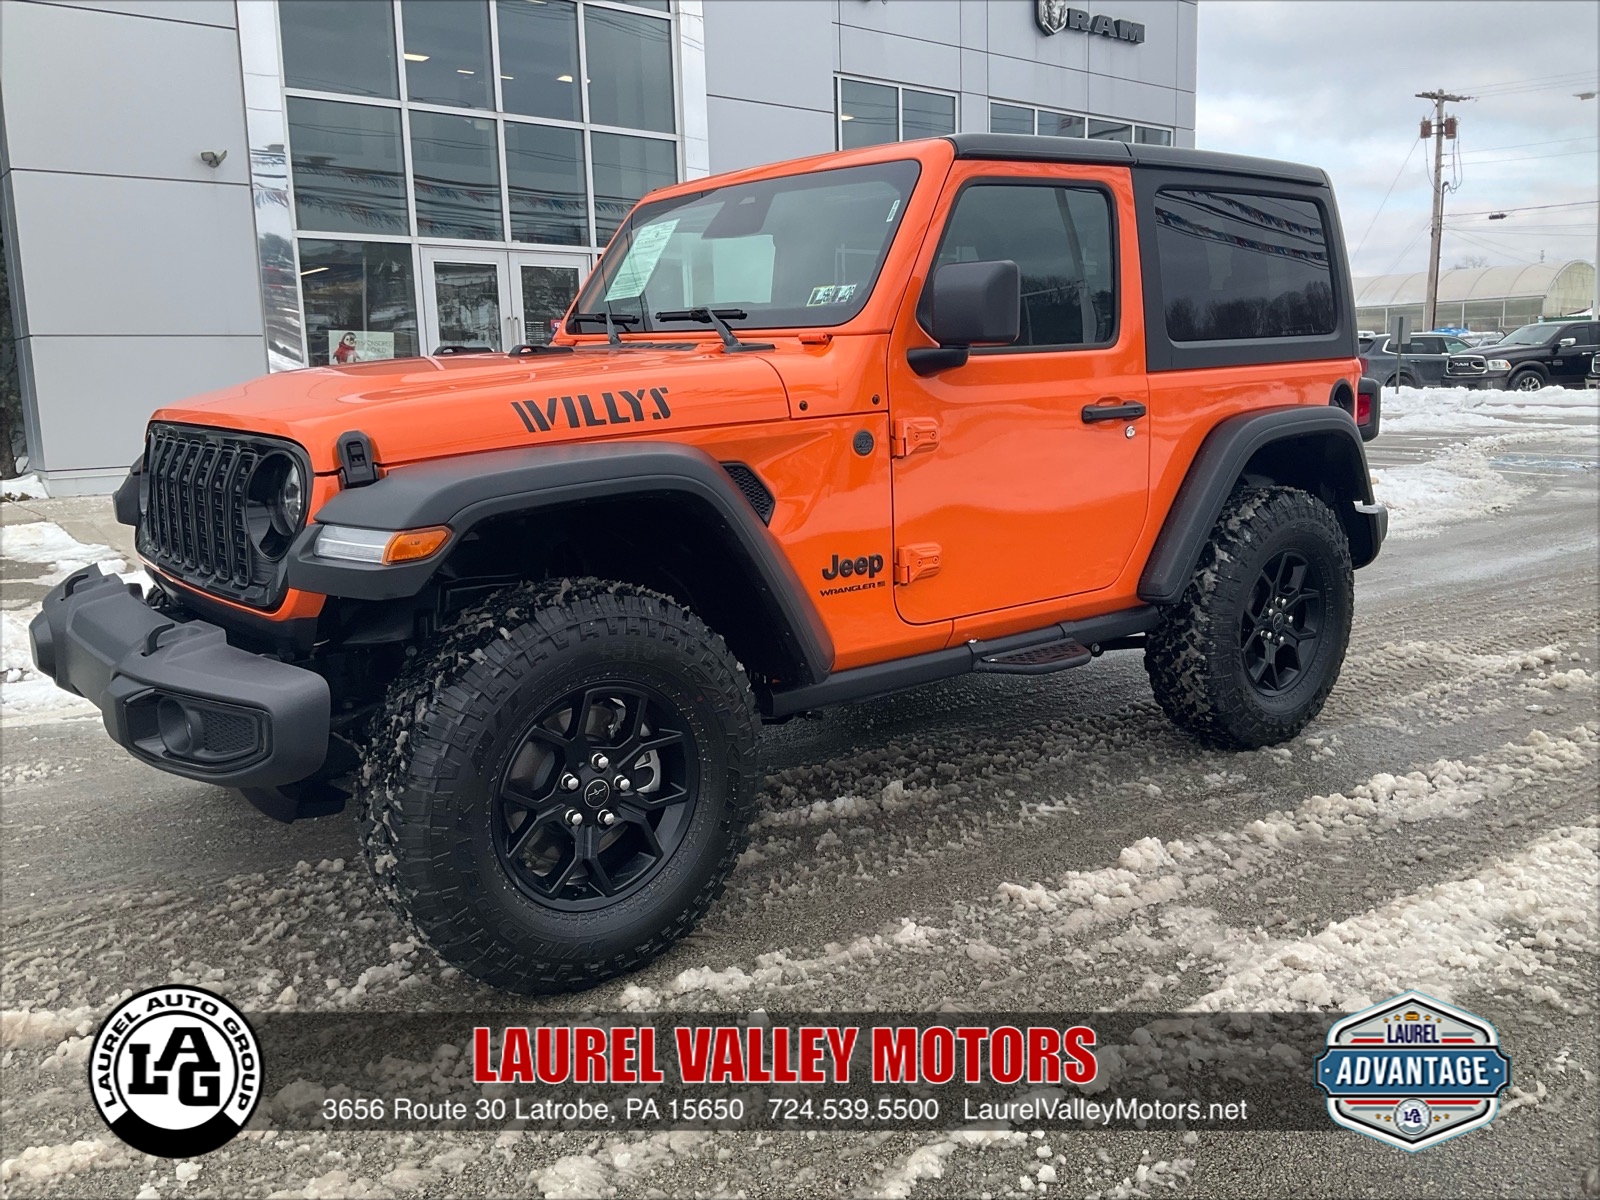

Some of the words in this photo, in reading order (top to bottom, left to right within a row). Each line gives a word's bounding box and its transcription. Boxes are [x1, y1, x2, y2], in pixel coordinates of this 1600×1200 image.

[1065, 8, 1145, 44] RAM
[511, 387, 672, 432] WILLYS
[822, 554, 884, 580] Jeep
[820, 582, 876, 597] WRANGLER
